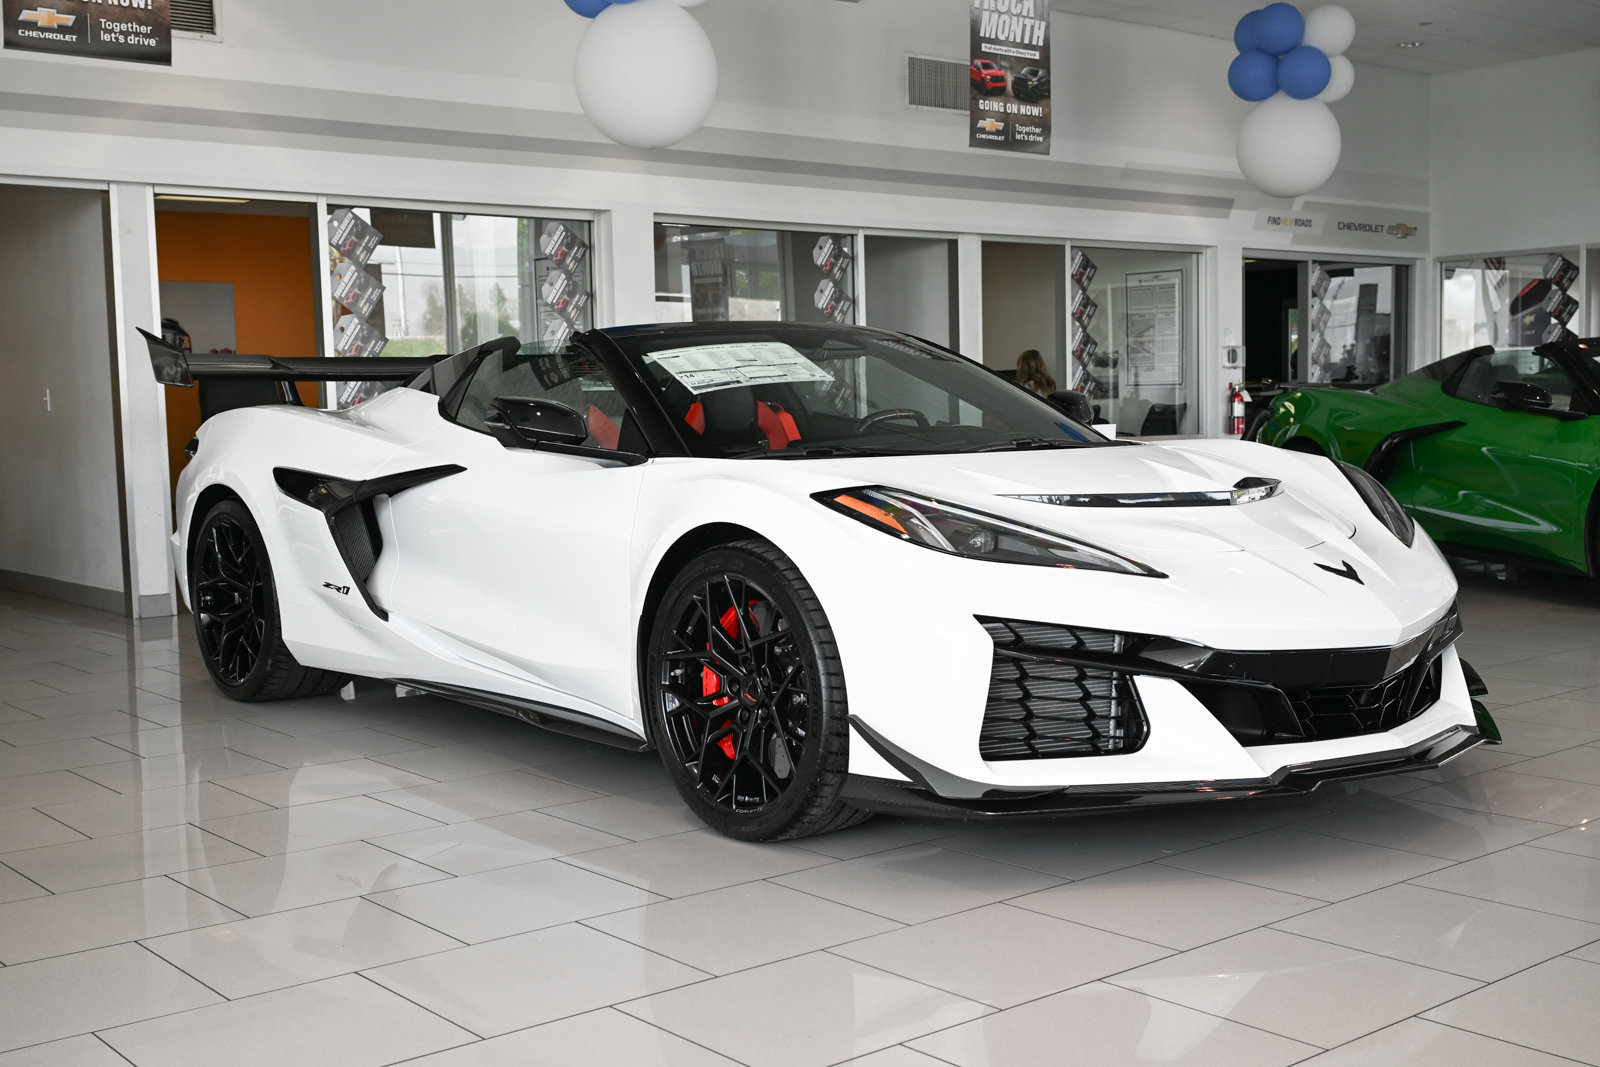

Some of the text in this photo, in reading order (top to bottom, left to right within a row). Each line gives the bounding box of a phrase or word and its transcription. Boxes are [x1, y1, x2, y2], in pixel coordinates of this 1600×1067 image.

[99, 18, 152, 34] Together
[980, 10, 1046, 46] MONTH
[18, 29, 78, 42] CHEVROLET
[100, 30, 125, 43] let's
[979, 99, 1042, 116] GOING ON NOW!
[1015, 124, 1042, 134] Together
[976, 133, 1005, 141] CHEVROLET
[1337, 221, 1385, 233] CHEVROLET
[323, 581, 350, 595] ZR1
